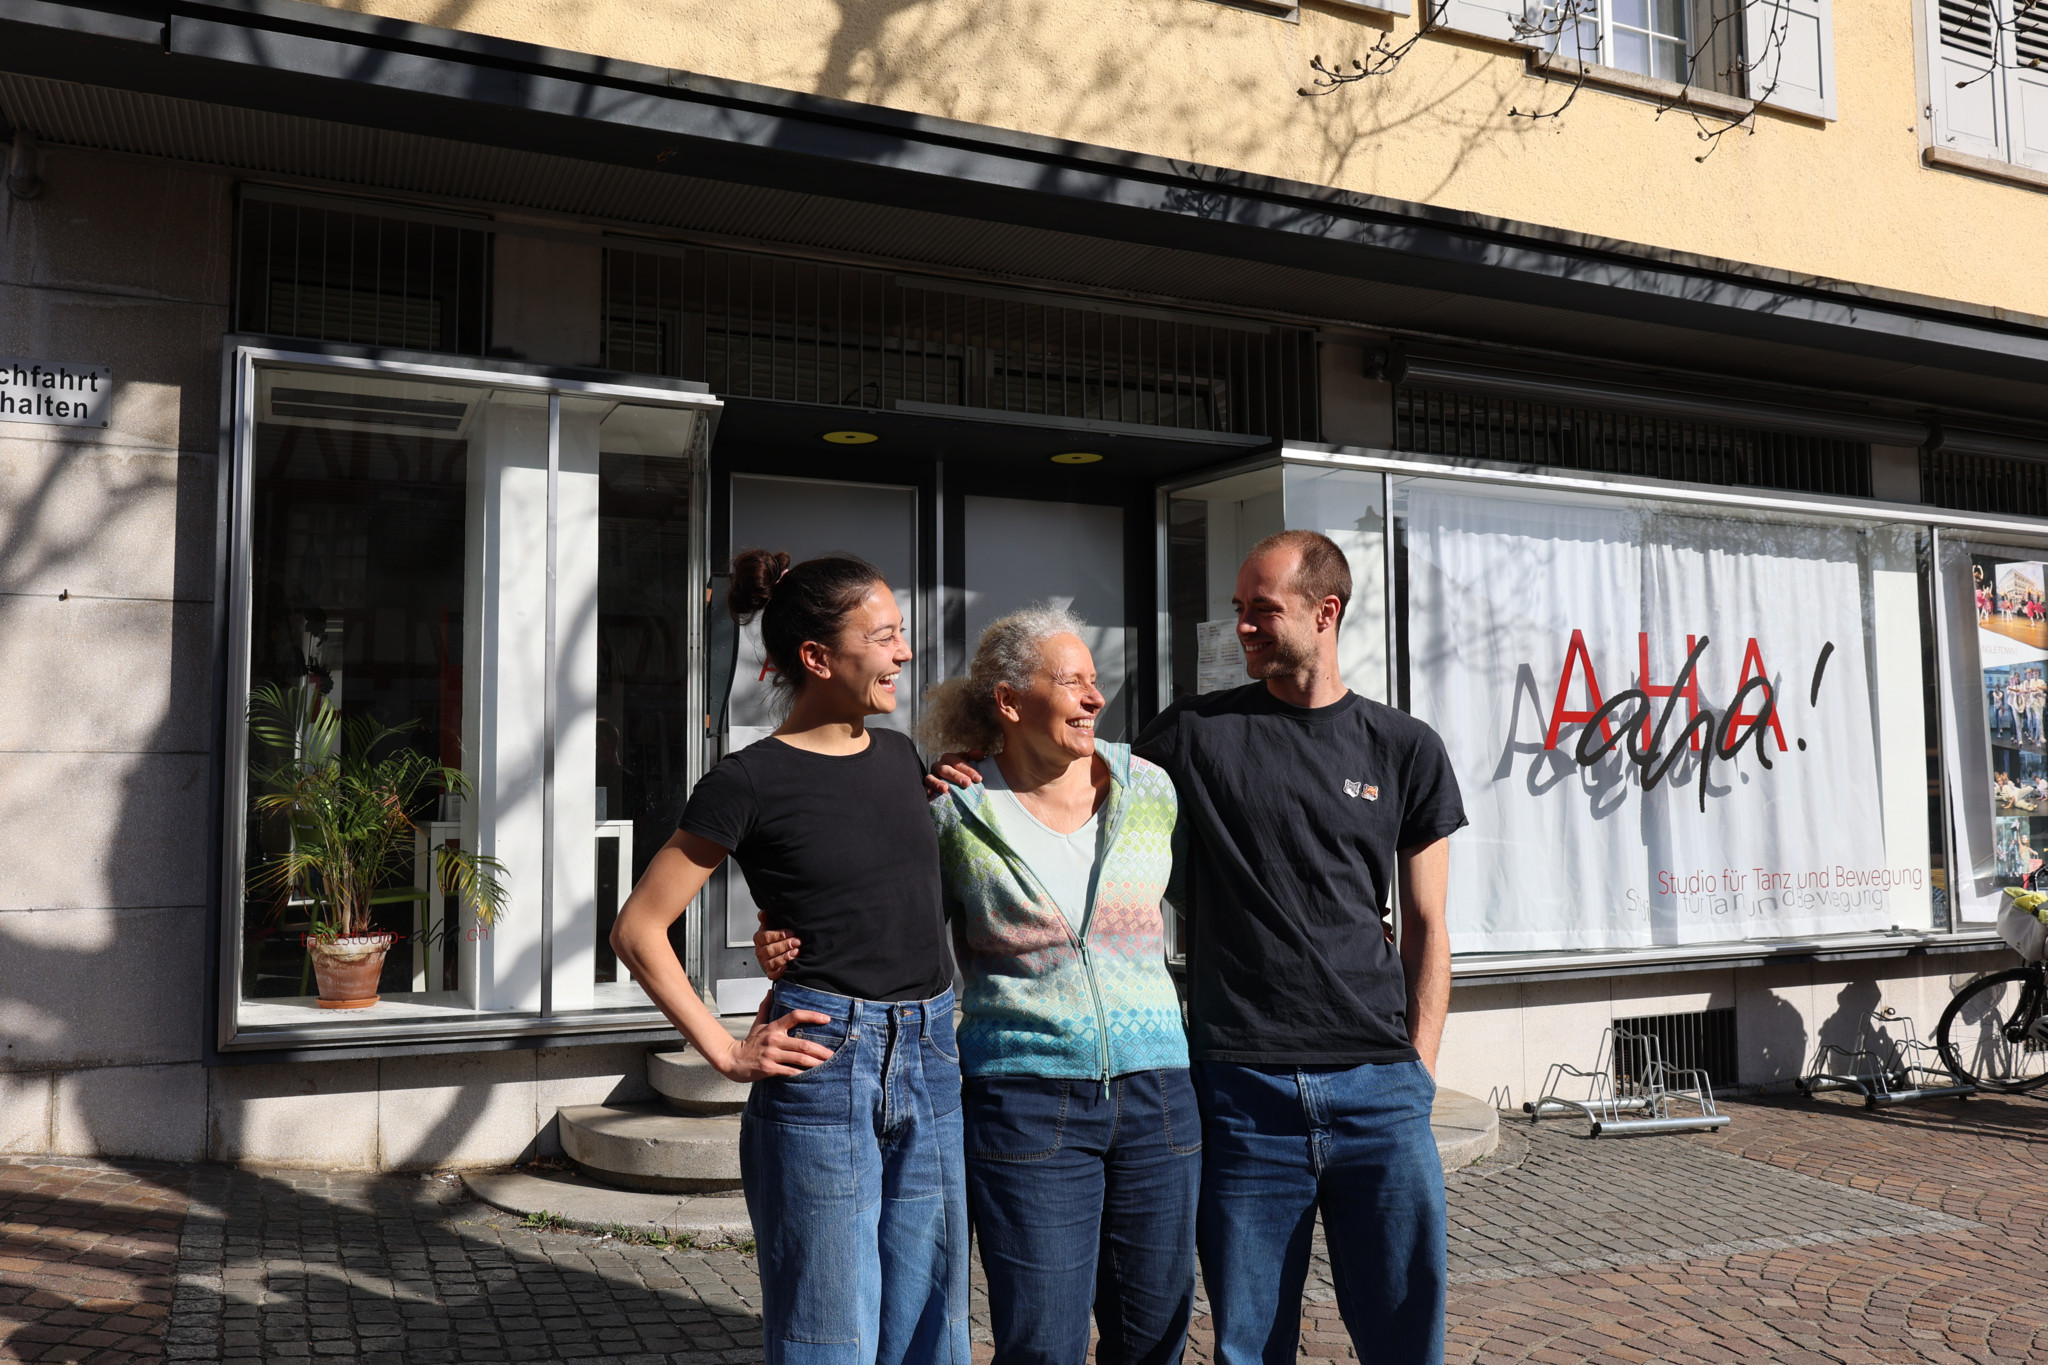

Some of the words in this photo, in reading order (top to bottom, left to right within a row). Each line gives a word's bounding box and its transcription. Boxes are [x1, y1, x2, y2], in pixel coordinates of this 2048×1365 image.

[0, 363, 98, 392] chfahrt
[0, 391, 88, 419] halten
[1544, 628, 1788, 752] AHA
[1658, 868, 1717, 895] Studio
[1722, 868, 1748, 892] für
[1752, 867, 1792, 891] Tanz
[1796, 865, 1830, 889] und
[1835, 865, 1923, 891] Bewegung
